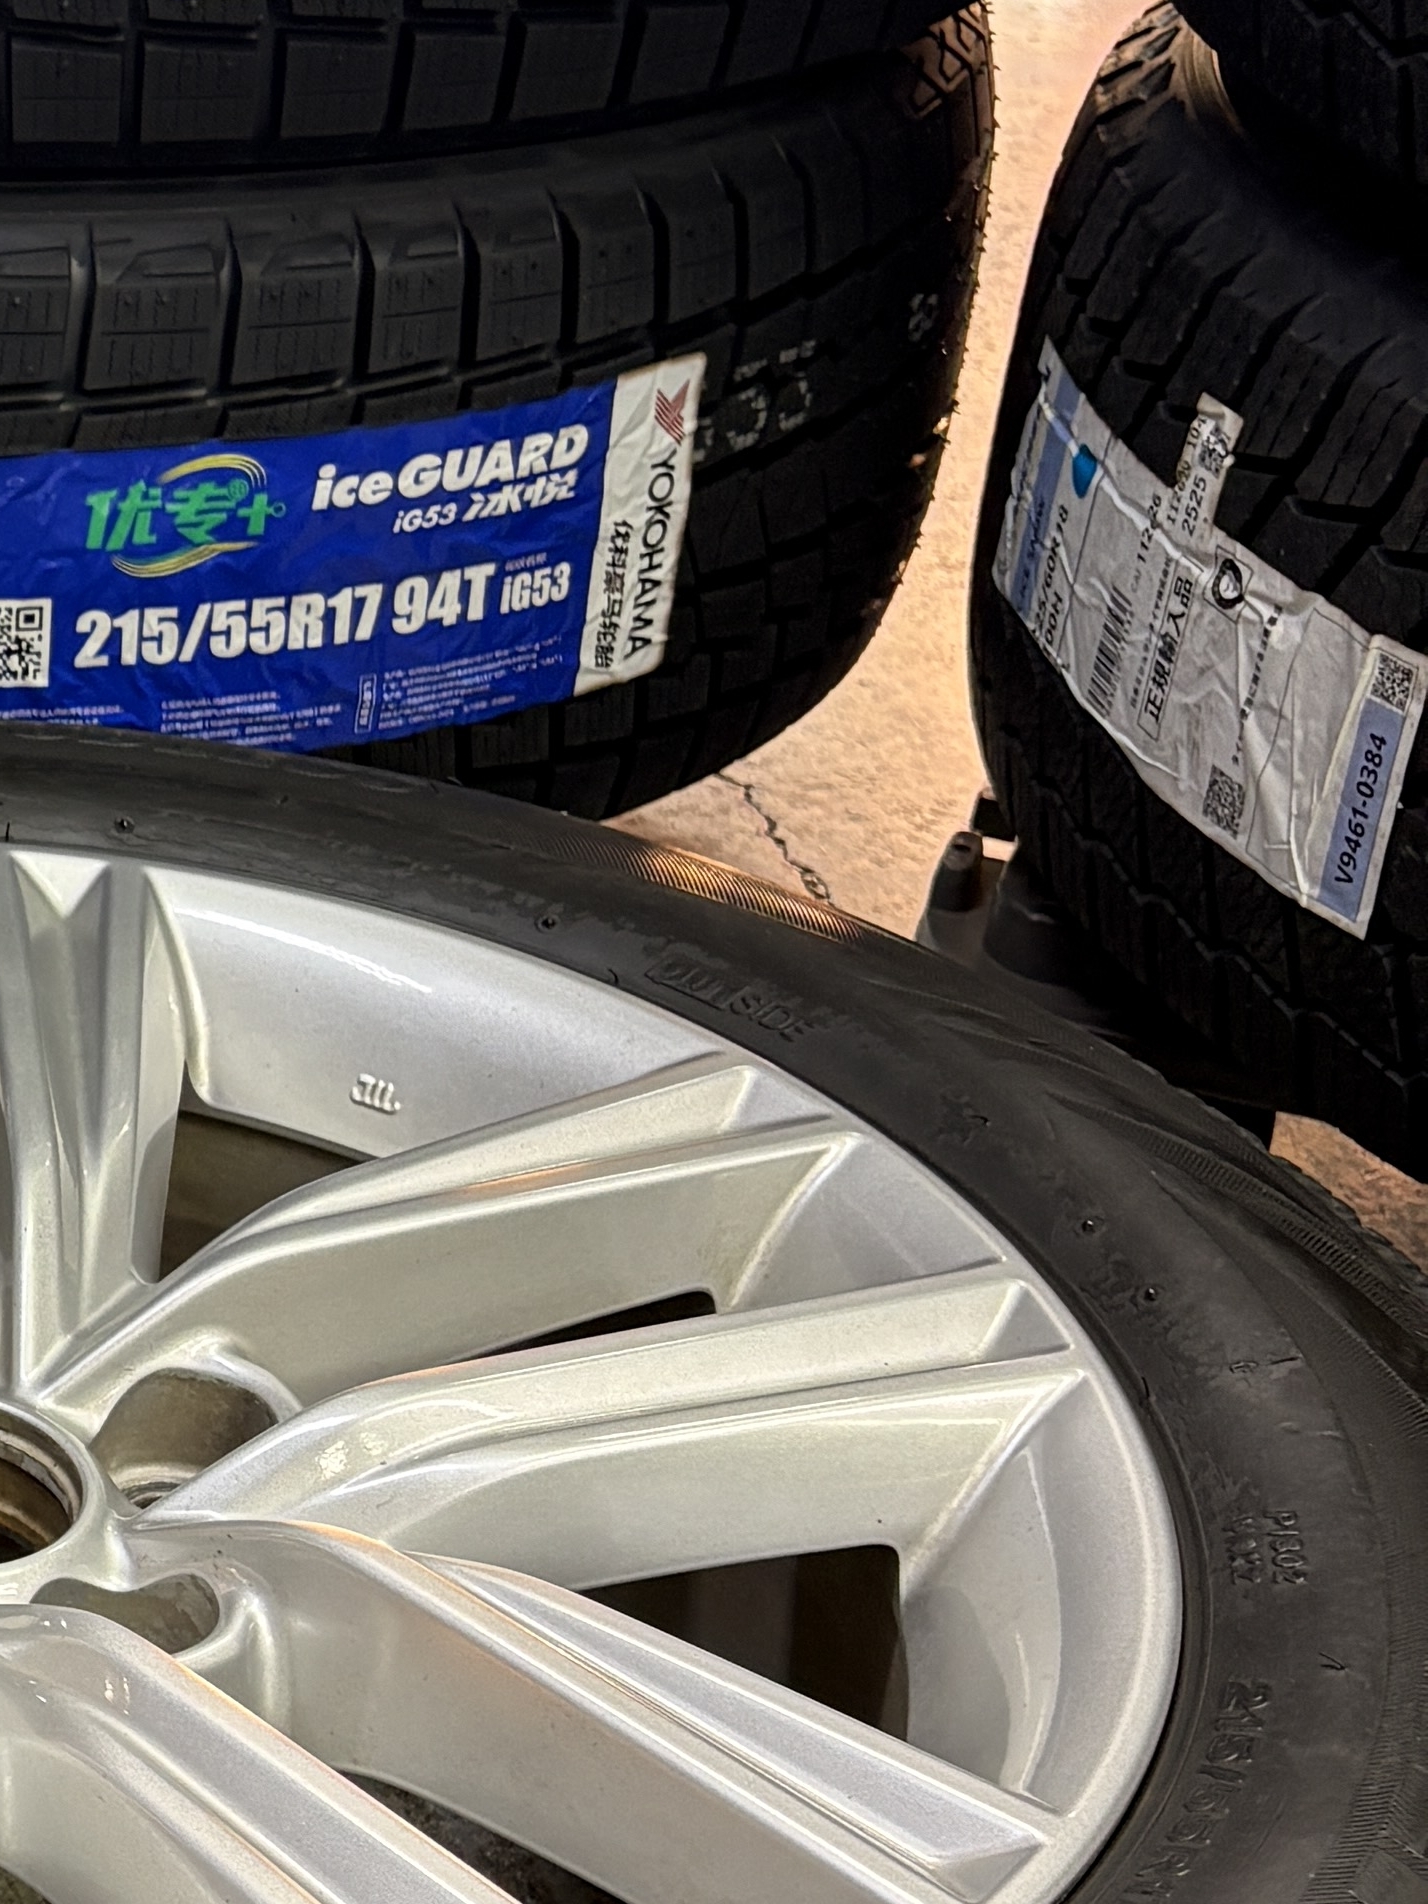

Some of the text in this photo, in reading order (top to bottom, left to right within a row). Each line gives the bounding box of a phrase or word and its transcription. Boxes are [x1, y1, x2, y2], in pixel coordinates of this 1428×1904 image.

[392, 503, 459, 535] iG53
[623, 446, 678, 661] YOKOHAMA
[1181, 475, 1208, 538] 2525
[74, 563, 497, 671] 215/55R17 94T
[499, 561, 572, 620] iG53
[1145, 575, 1195, 726] 正規輸入品
[1333, 731, 1387, 887] V9461-0384
